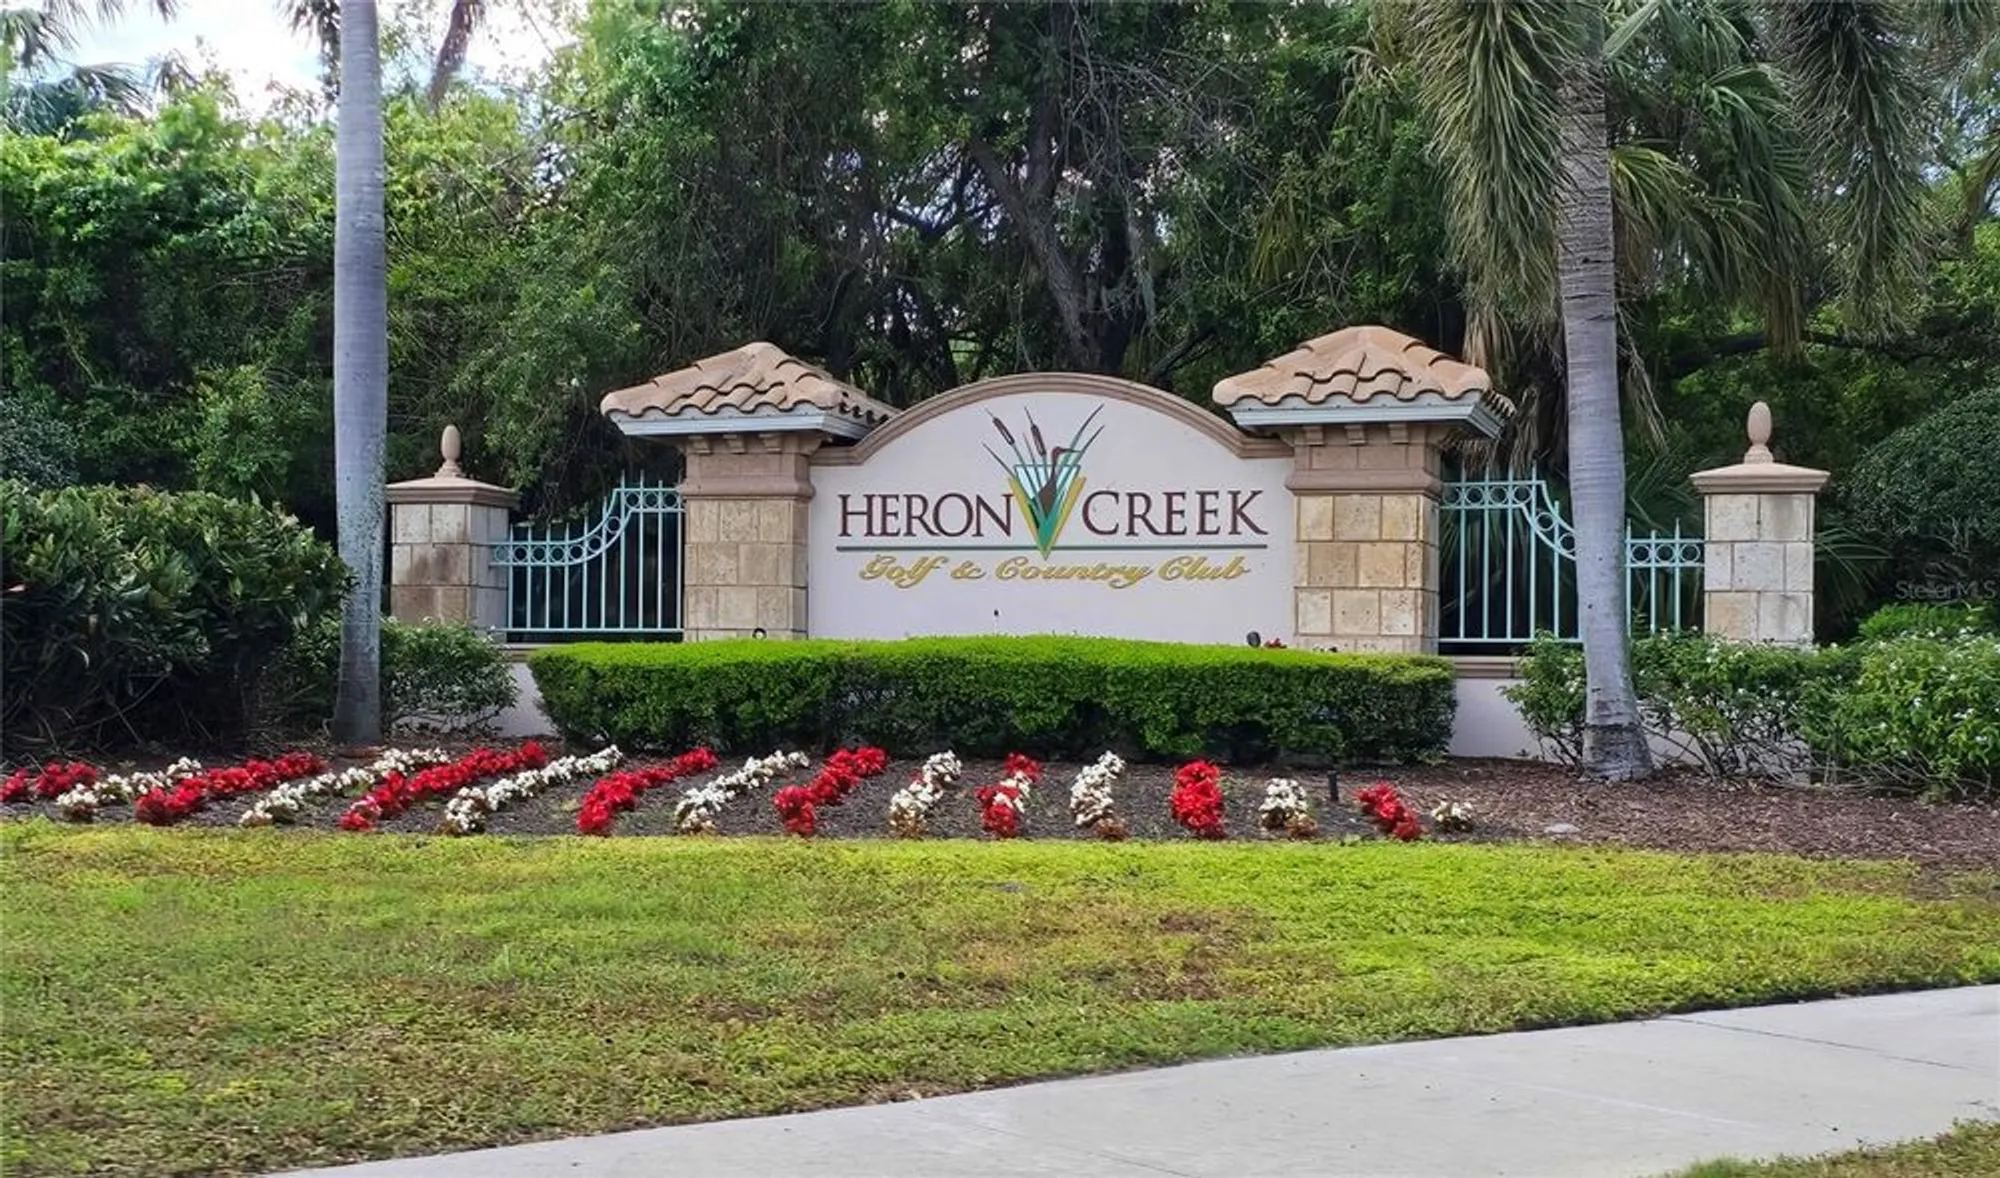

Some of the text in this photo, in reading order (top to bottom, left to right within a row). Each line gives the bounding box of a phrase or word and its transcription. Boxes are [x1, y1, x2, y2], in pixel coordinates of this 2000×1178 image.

[838, 490, 1268, 537] HERON CREEK
[859, 554, 1251, 589] Golf & Country Club
